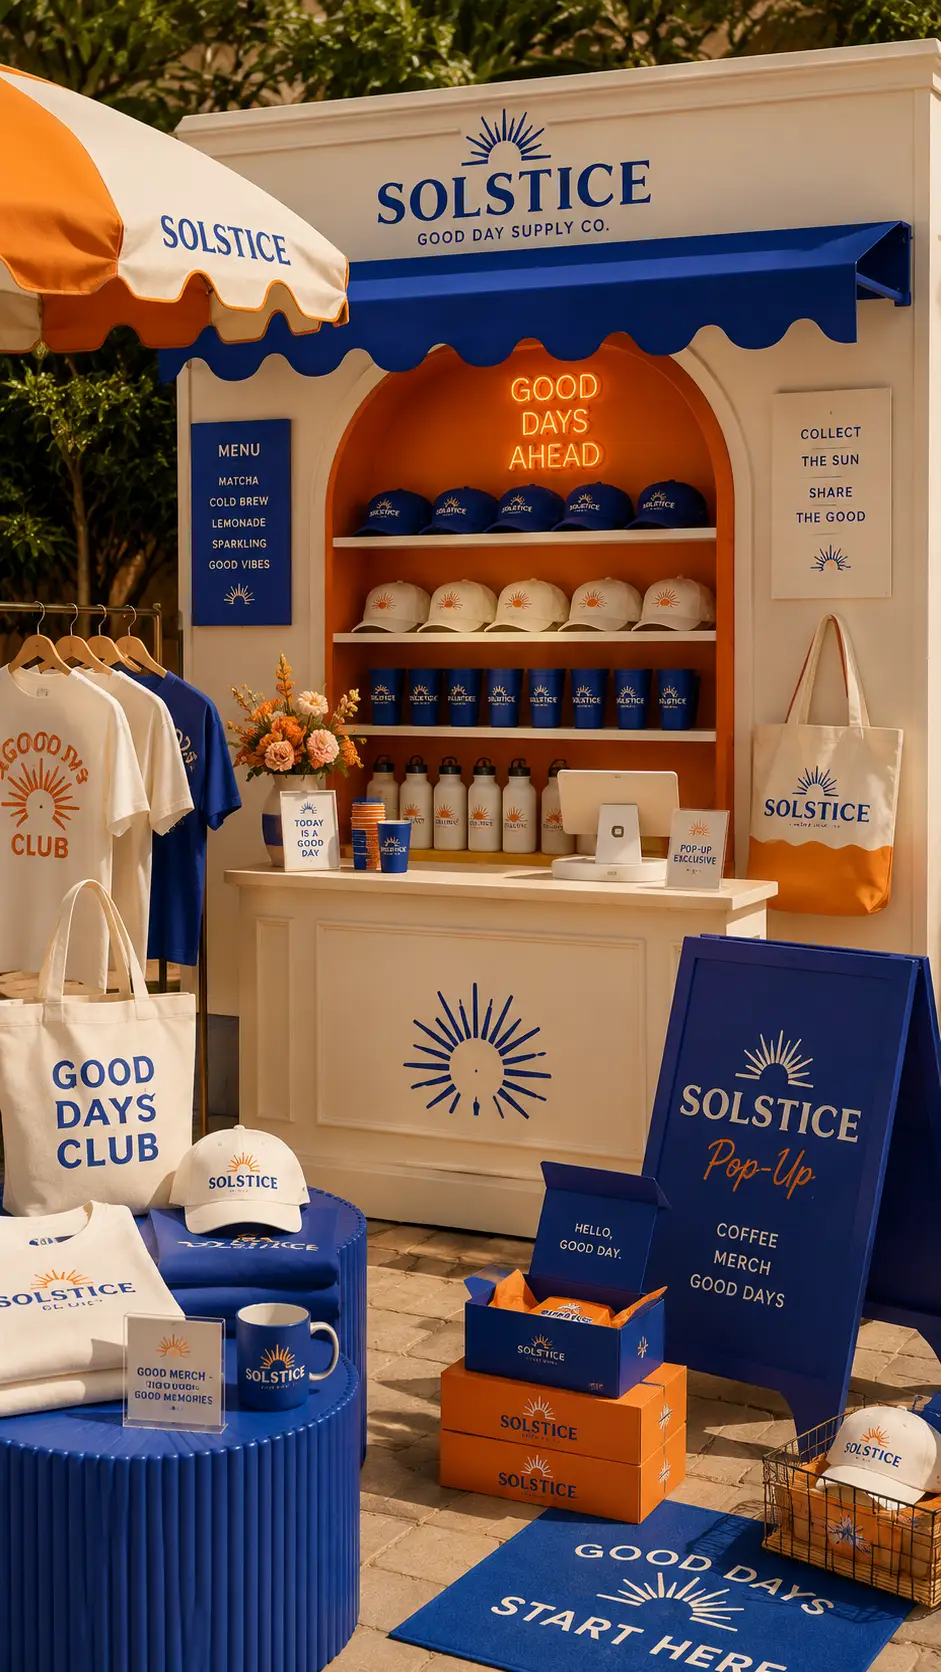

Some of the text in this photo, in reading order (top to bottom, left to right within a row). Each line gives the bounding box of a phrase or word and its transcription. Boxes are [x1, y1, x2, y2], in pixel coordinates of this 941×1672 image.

[377, 159, 652, 225] SOLSTICE
[160, 214, 292, 266] SOLSTICE
[417, 218, 610, 246] GOOD DAY SUPPLY CO.
[511, 373, 598, 402] GOOD
[522, 408, 588, 435] DAYS
[800, 426, 862, 440] COLLECT
[218, 443, 261, 458] MENU
[508, 442, 600, 470] AHEAD
[801, 454, 859, 467] THE SUN
[218, 476, 259, 486] MATCHA
[809, 486, 853, 499] SHARE
[209, 496, 269, 507] COLD BREW
[212, 518, 266, 528] LEMONADE
[796, 510, 866, 523] THE GOOD
[212, 539, 267, 549] SPARKLING
[208, 559, 270, 570] GOOD VIBES
[2, 731, 61, 764] GOOD
[764, 798, 871, 823] SOLSTICE
[294, 819, 324, 828] TODAY
[301, 829, 318, 837] IS A
[11, 833, 69, 859] CLUB
[297, 839, 324, 847] GOOD
[301, 849, 320, 857] DAY
[680, 844, 712, 854] POP-UP
[673, 854, 717, 865] EXCLUSIVE
[52, 1055, 155, 1090] GOOD
[55, 1092, 157, 1129] DAYS
[679, 1084, 862, 1143] SOLSTICE
[57, 1132, 159, 1170] CLUB
[703, 1138, 817, 1200] Pop-Up
[208, 1174, 278, 1190] SOLSTICE
[574, 1222, 613, 1241] HELLO,
[716, 1222, 779, 1248] COFFEE
[559, 1239, 622, 1260] GOOD DAY.
[713, 1250, 771, 1276] MERCH
[0, 1282, 136, 1308] SOLSTICE
[690, 1273, 785, 1308] GOOD DAYS
[517, 1344, 565, 1362] SOLSTICE
[137, 1366, 167, 1378] GOOD
[169, 1369, 206, 1381] MERCH
[245, 1364, 306, 1384] SOLSTICE
[163, 1392, 213, 1405] MEMORIES
[500, 1414, 577, 1441] SOLSTICE
[843, 1442, 903, 1468] SOLSTICE
[498, 1471, 577, 1499] SOLSTICE
[574, 1543, 835, 1616] GOOD DAYS
[490, 1595, 644, 1645] START
